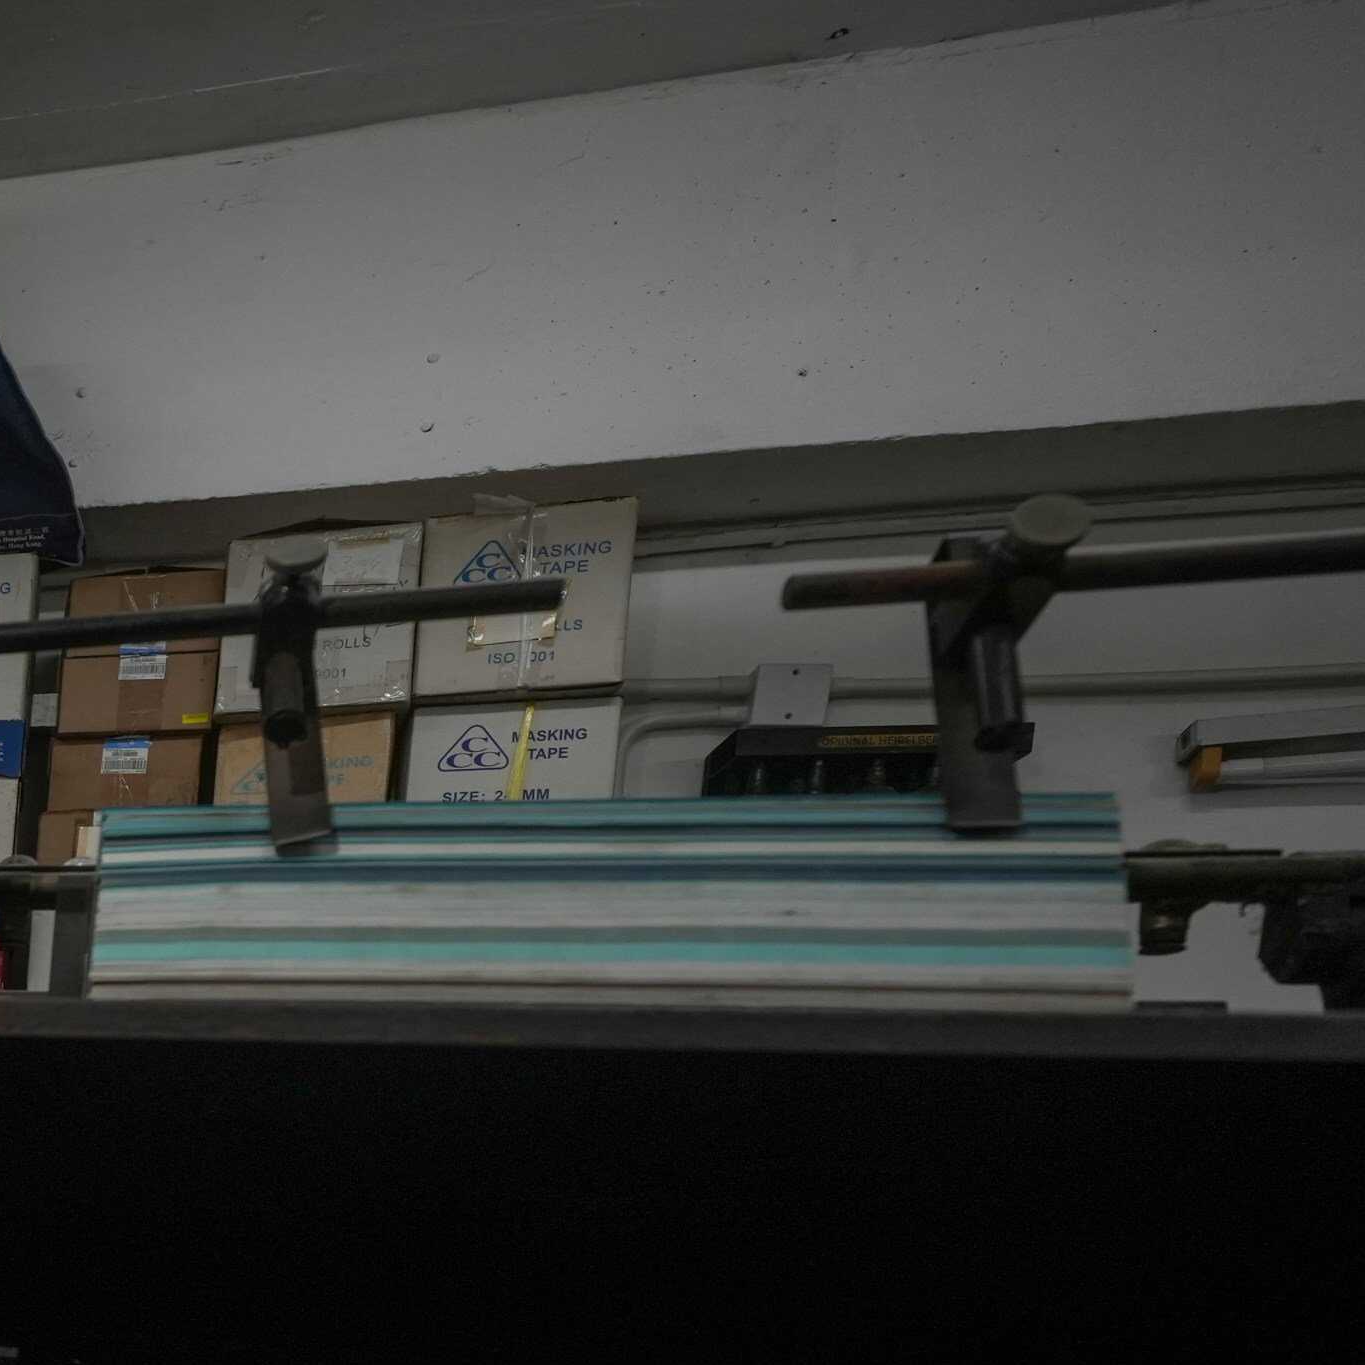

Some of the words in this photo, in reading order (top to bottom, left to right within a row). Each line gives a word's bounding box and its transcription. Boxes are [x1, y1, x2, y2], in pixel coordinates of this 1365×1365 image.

[540, 559, 589, 575] TAPE
[555, 619, 583, 632] LLS
[322, 637, 372, 650] ROLLS
[487, 652, 515, 664] ISO
[317, 668, 347, 680] 001
[878, 734, 935, 745] HEIDELBE
[528, 747, 569, 760] TAPE
[442, 791, 486, 803] SIZE:
